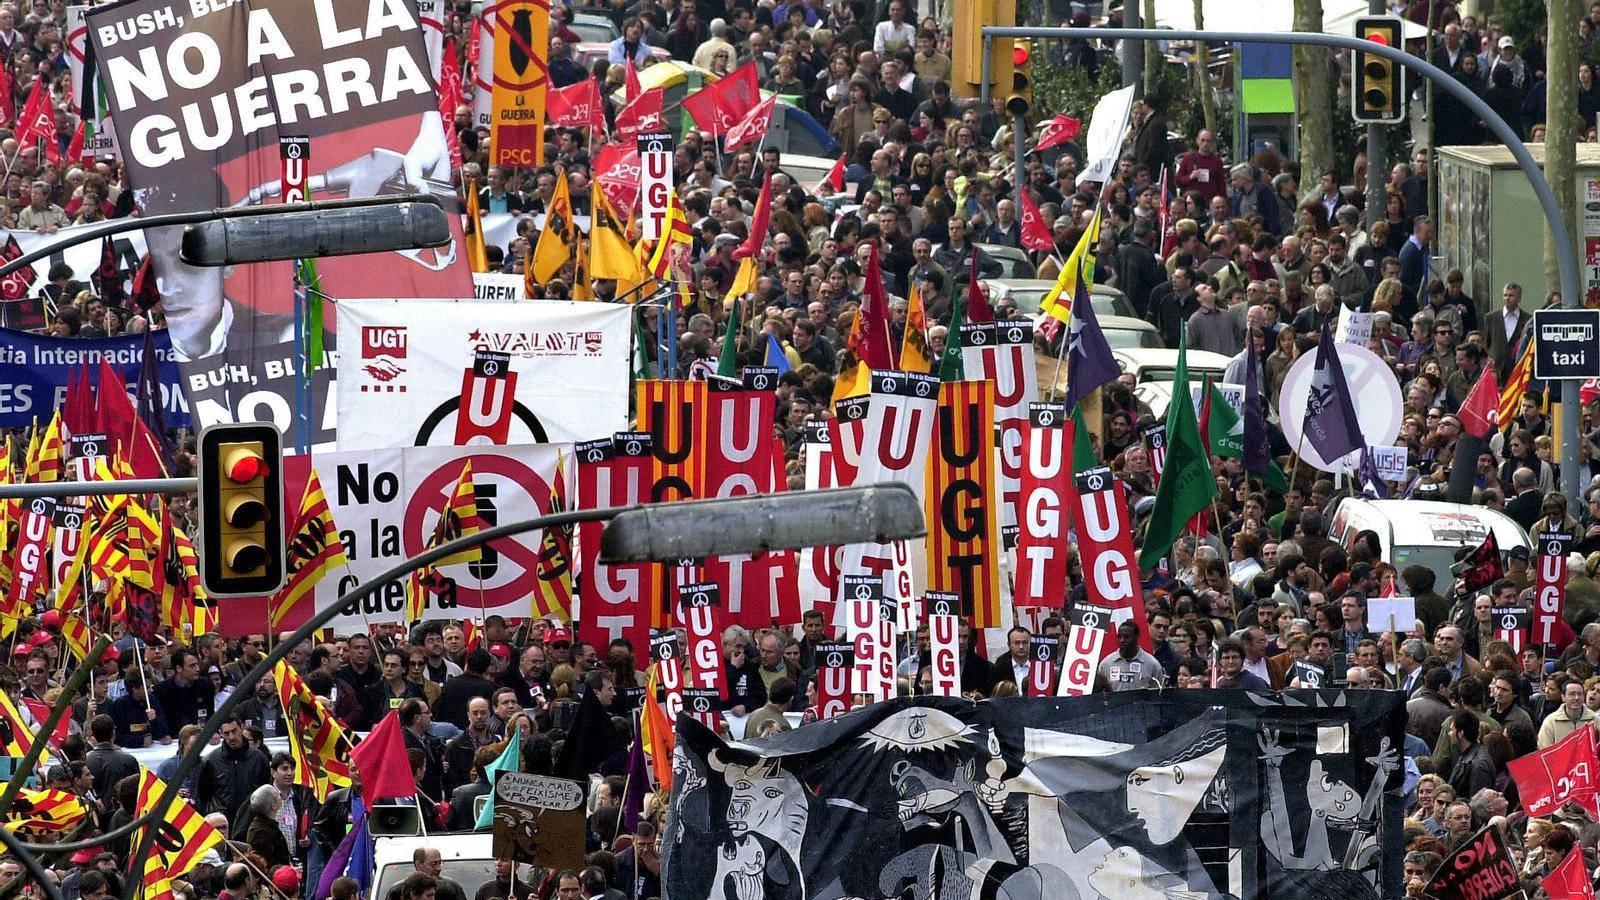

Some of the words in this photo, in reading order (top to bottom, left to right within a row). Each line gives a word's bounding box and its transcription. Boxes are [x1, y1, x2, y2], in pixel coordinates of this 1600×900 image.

[97, 6, 184, 48] BUSH,
[189, 0, 242, 19] BL
[107, 32, 221, 111] NO
[246, 8, 295, 67] A
[317, 0, 419, 50] LA
[129, 46, 434, 168] GUERRA
[501, 109, 536, 120] GUERRA
[500, 149, 532, 165] PSC
[648, 153, 668, 238] UGT
[0, 345, 26, 365] tia
[369, 329, 407, 348] UGT
[1552, 350, 1585, 365] taxi
[189, 362, 257, 392] BUH,
[196, 390, 292, 434] NO
[337, 463, 399, 506] No
[940, 403, 983, 617] UGT
[1026, 428, 1063, 597] UGT
[19, 512, 46, 600] UGT
[339, 529, 357, 560] a
[371, 518, 400, 558] la
[338, 574, 457, 616] Guea
[896, 540, 910, 629] UGT
[1540, 556, 1561, 642] UGT
[690, 606, 719, 689] UGT
[854, 601, 874, 691] UGT
[880, 621, 893, 701] UGT
[935, 616, 954, 696] UGT
[661, 659, 683, 727] UG
[519, 786, 576, 800] FEIXISME
